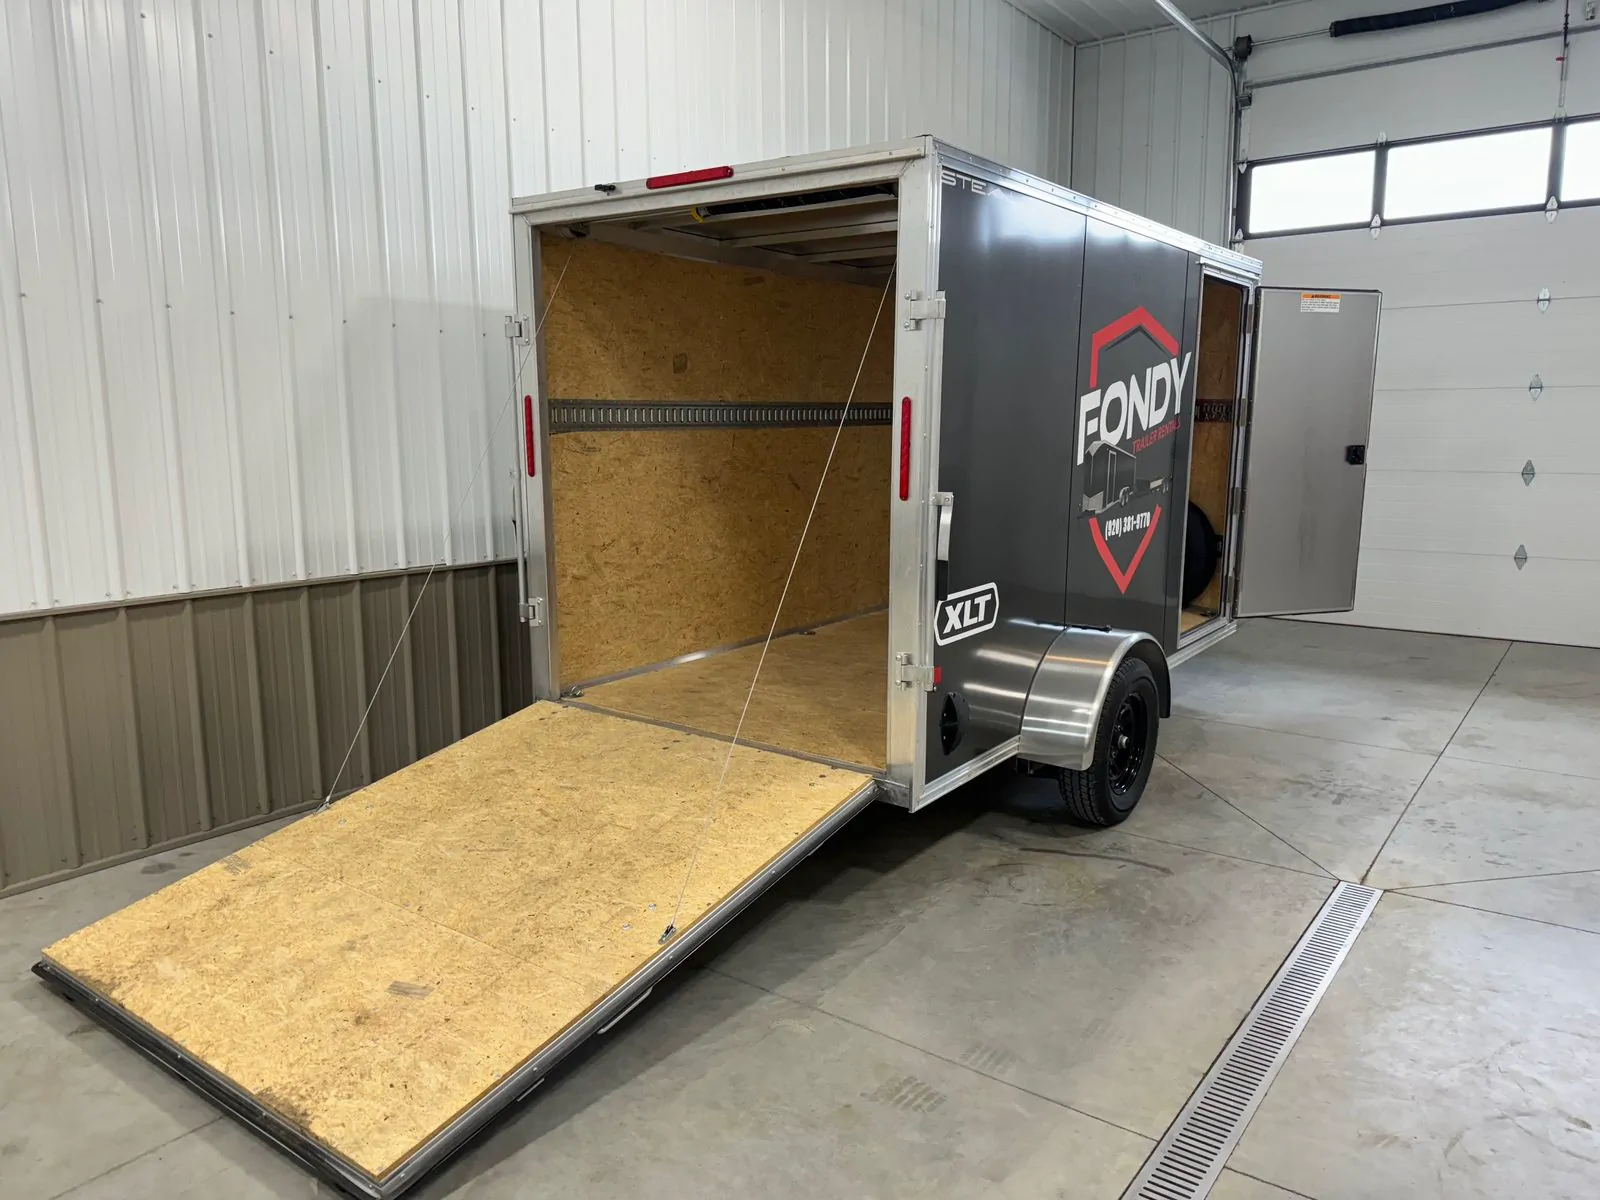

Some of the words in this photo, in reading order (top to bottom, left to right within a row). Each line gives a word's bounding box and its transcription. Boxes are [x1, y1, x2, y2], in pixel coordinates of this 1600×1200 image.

[1077, 351, 1192, 466] FONDY
[1132, 427, 1157, 455] TRAILER
[1105, 517, 1122, 541] (920)
[943, 593, 992, 634] XLT
